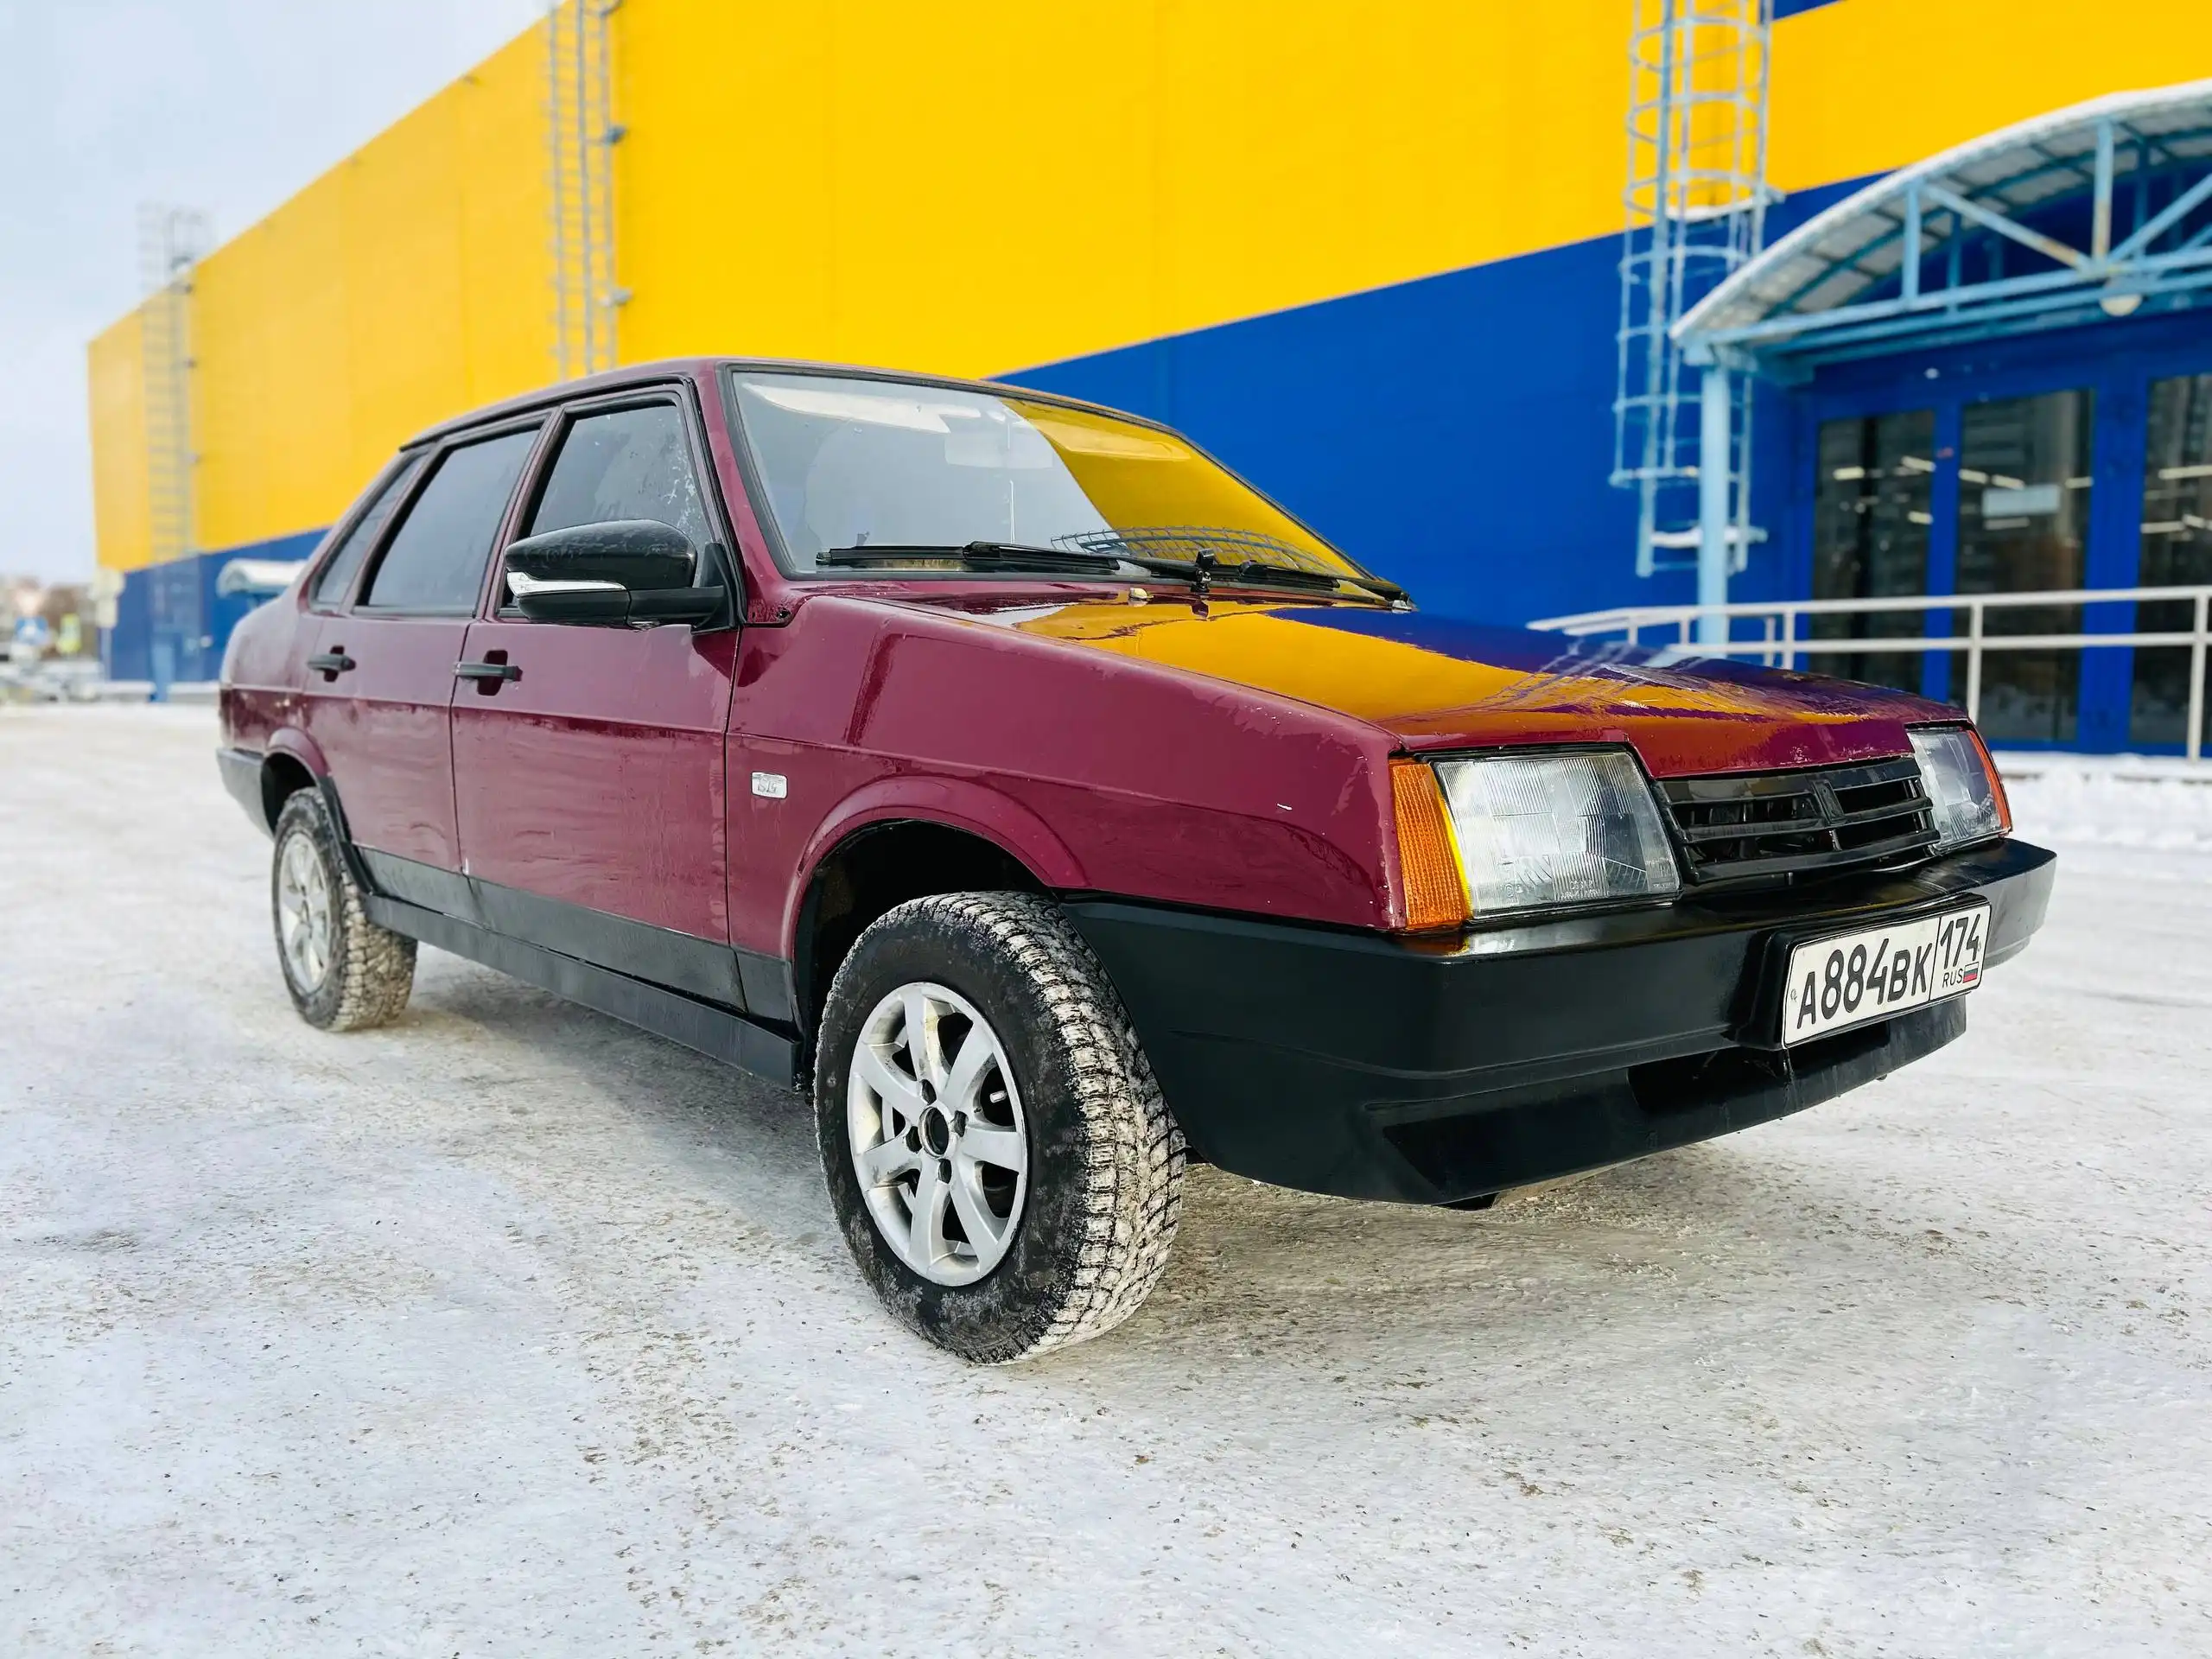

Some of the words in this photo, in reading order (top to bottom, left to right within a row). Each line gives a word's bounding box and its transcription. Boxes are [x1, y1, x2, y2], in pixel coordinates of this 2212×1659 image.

[1796, 938, 1933, 1029] А884ВК
[1940, 913, 1981, 969] 174
[1942, 968, 1963, 988] RUS
